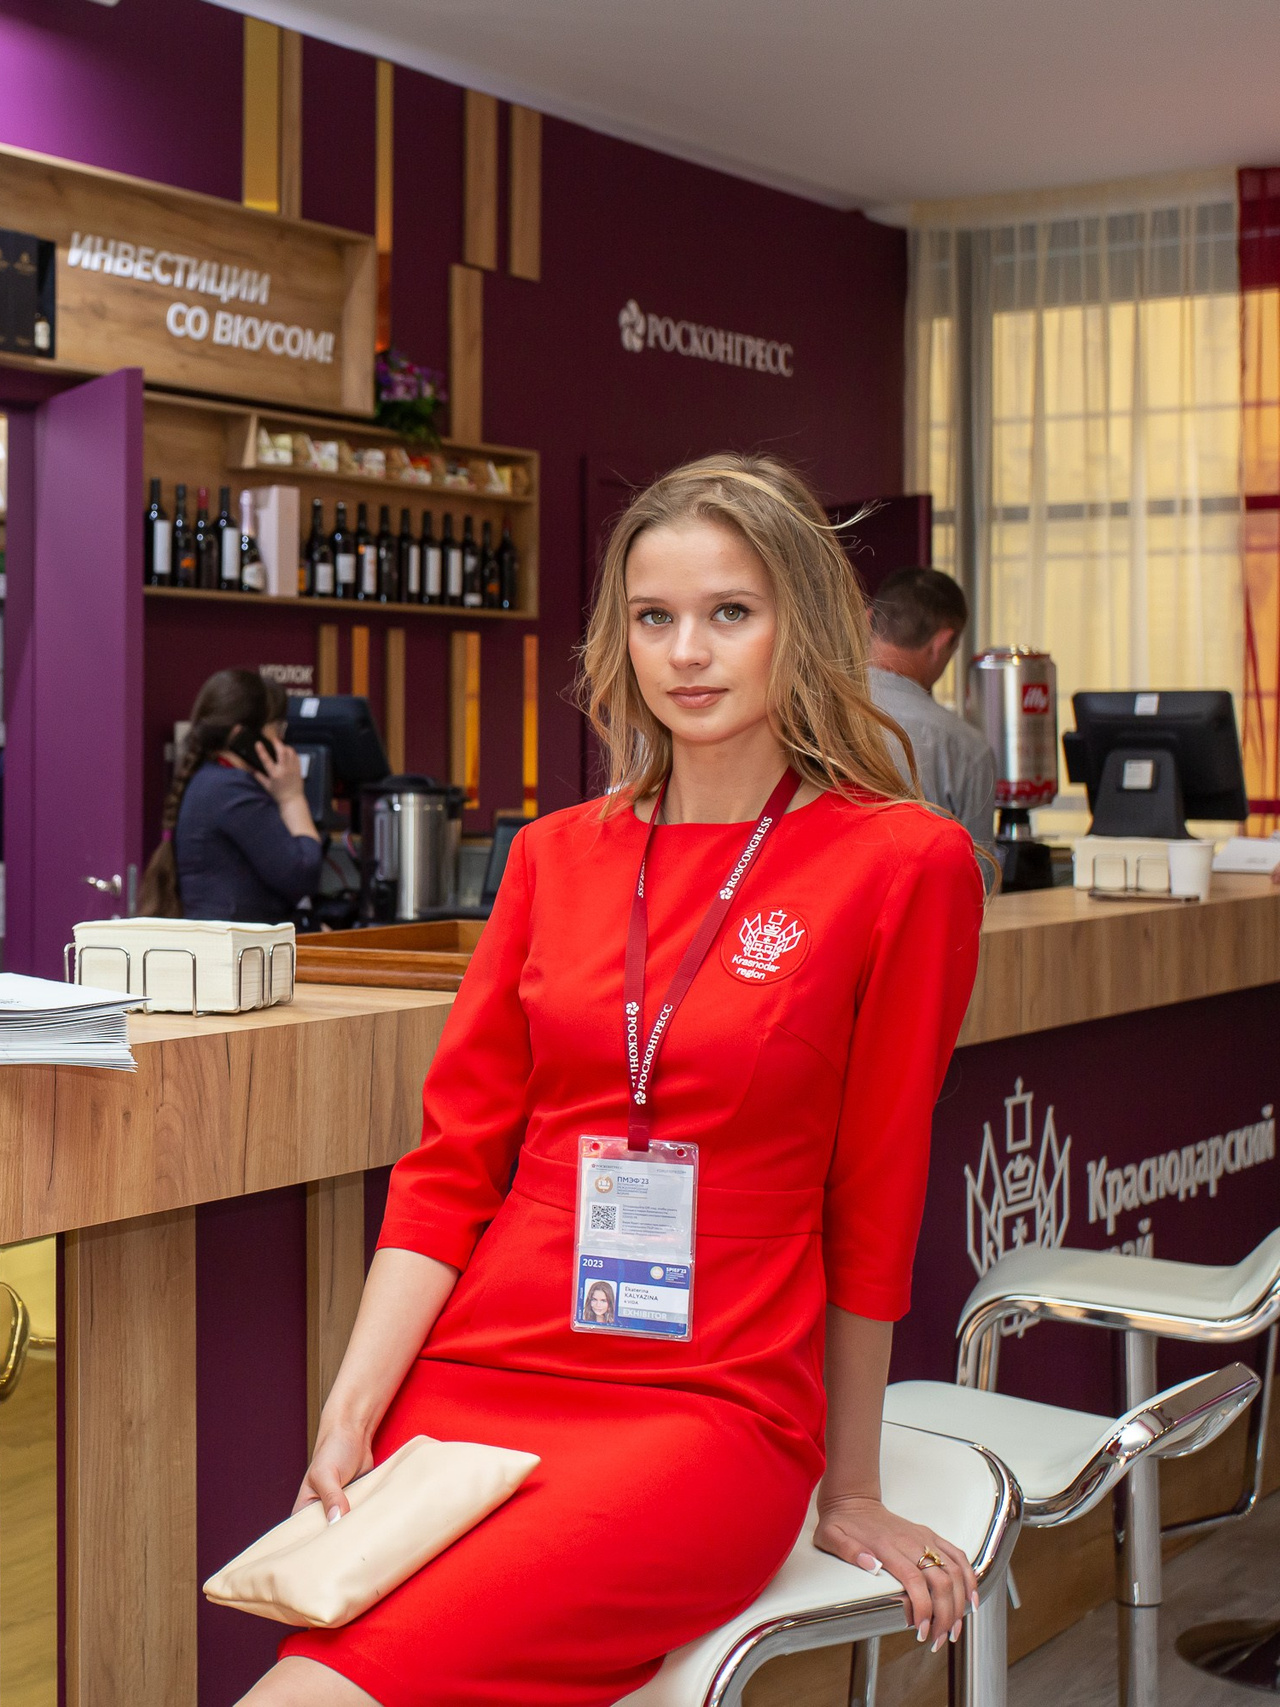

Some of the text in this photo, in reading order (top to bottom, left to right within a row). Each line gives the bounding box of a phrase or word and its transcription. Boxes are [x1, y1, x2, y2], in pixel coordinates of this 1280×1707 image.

[67, 232, 271, 305] ИНВЕСТИЦИИ
[166, 302, 335, 363] СО ВКУСОМ!
[646, 313, 794, 378] РОСКОНГРЕСС
[728, 816, 774, 889] ROSCONGRESS
[732, 954, 781, 972] Krasnodar
[736, 966, 766, 981] region
[638, 1003, 673, 1091] РОСКОНГРЕСС
[1087, 1104, 1276, 1236] Краснодарский
[582, 1258, 604, 1268] 2023
[623, 1308, 668, 1321] EXHIBITOR
